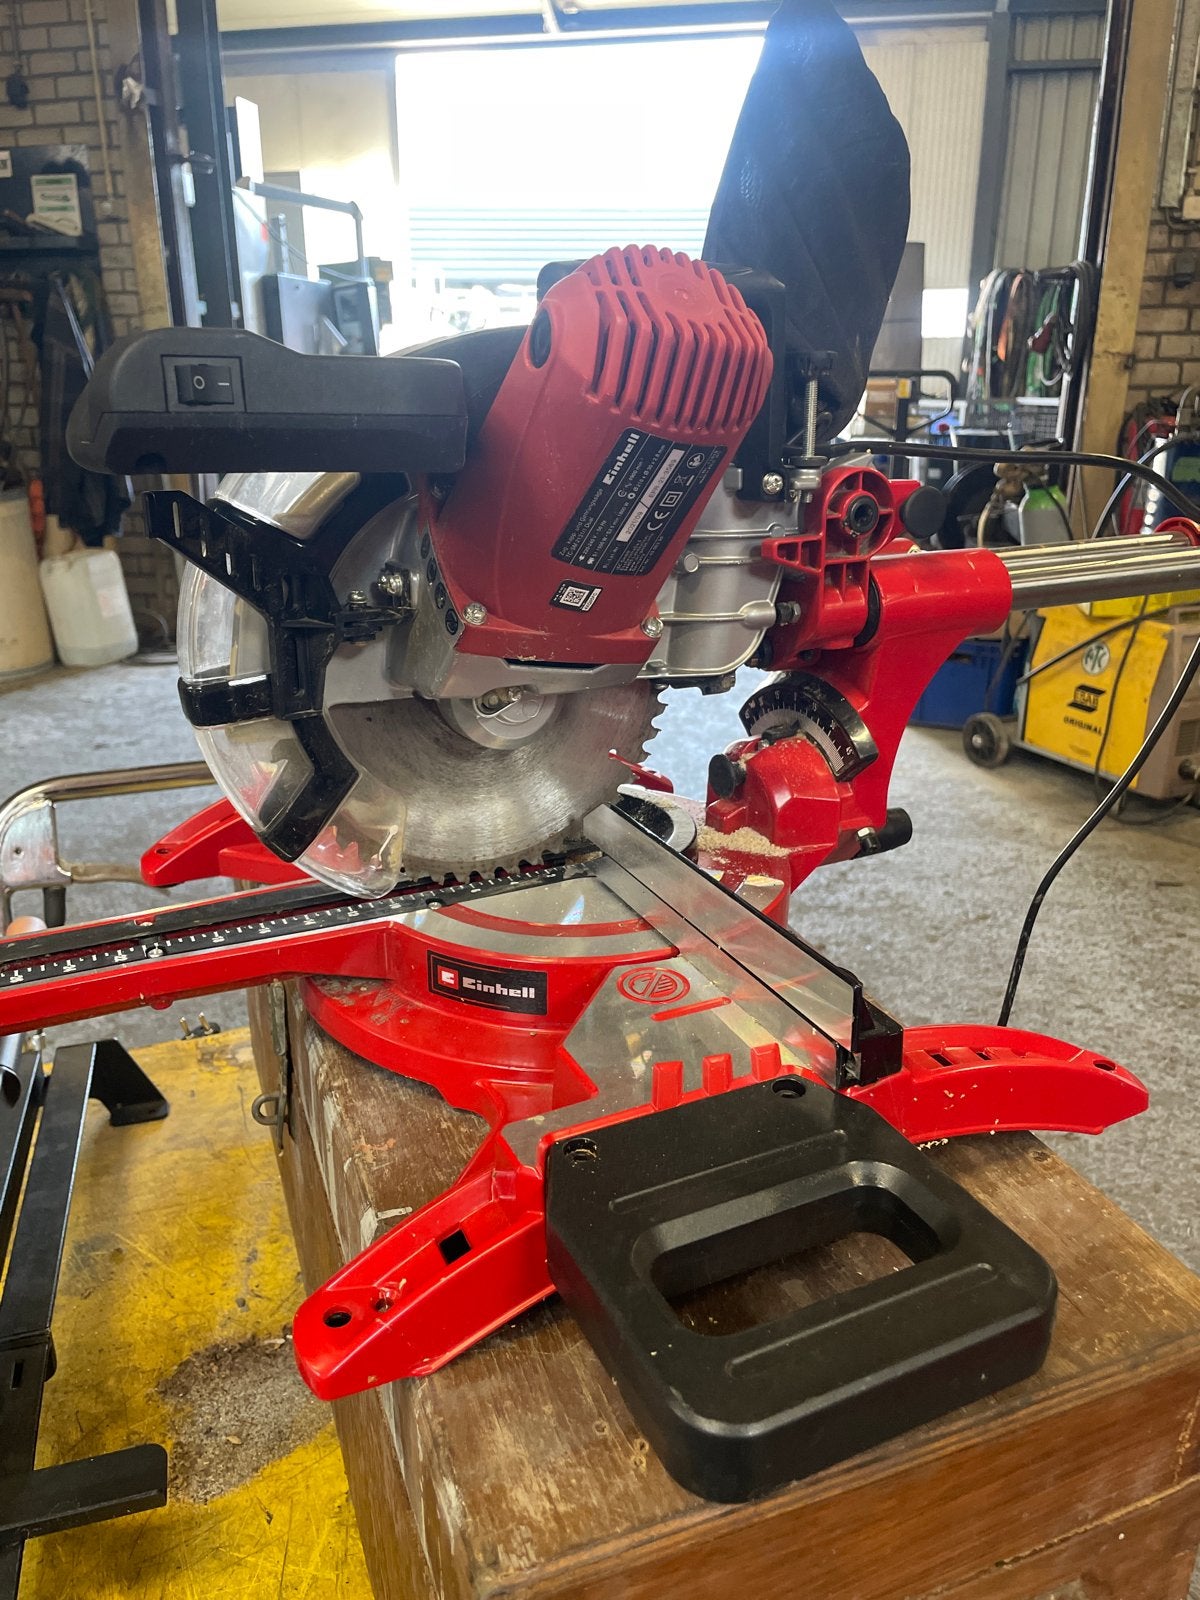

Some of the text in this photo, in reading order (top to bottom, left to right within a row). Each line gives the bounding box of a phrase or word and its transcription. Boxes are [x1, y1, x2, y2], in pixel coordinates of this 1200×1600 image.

[601, 433, 641, 485] Einhell
[584, 517, 595, 528] Dual
[1063, 715, 1102, 736] ORIGINAL
[462, 976, 536, 999] Einhell
